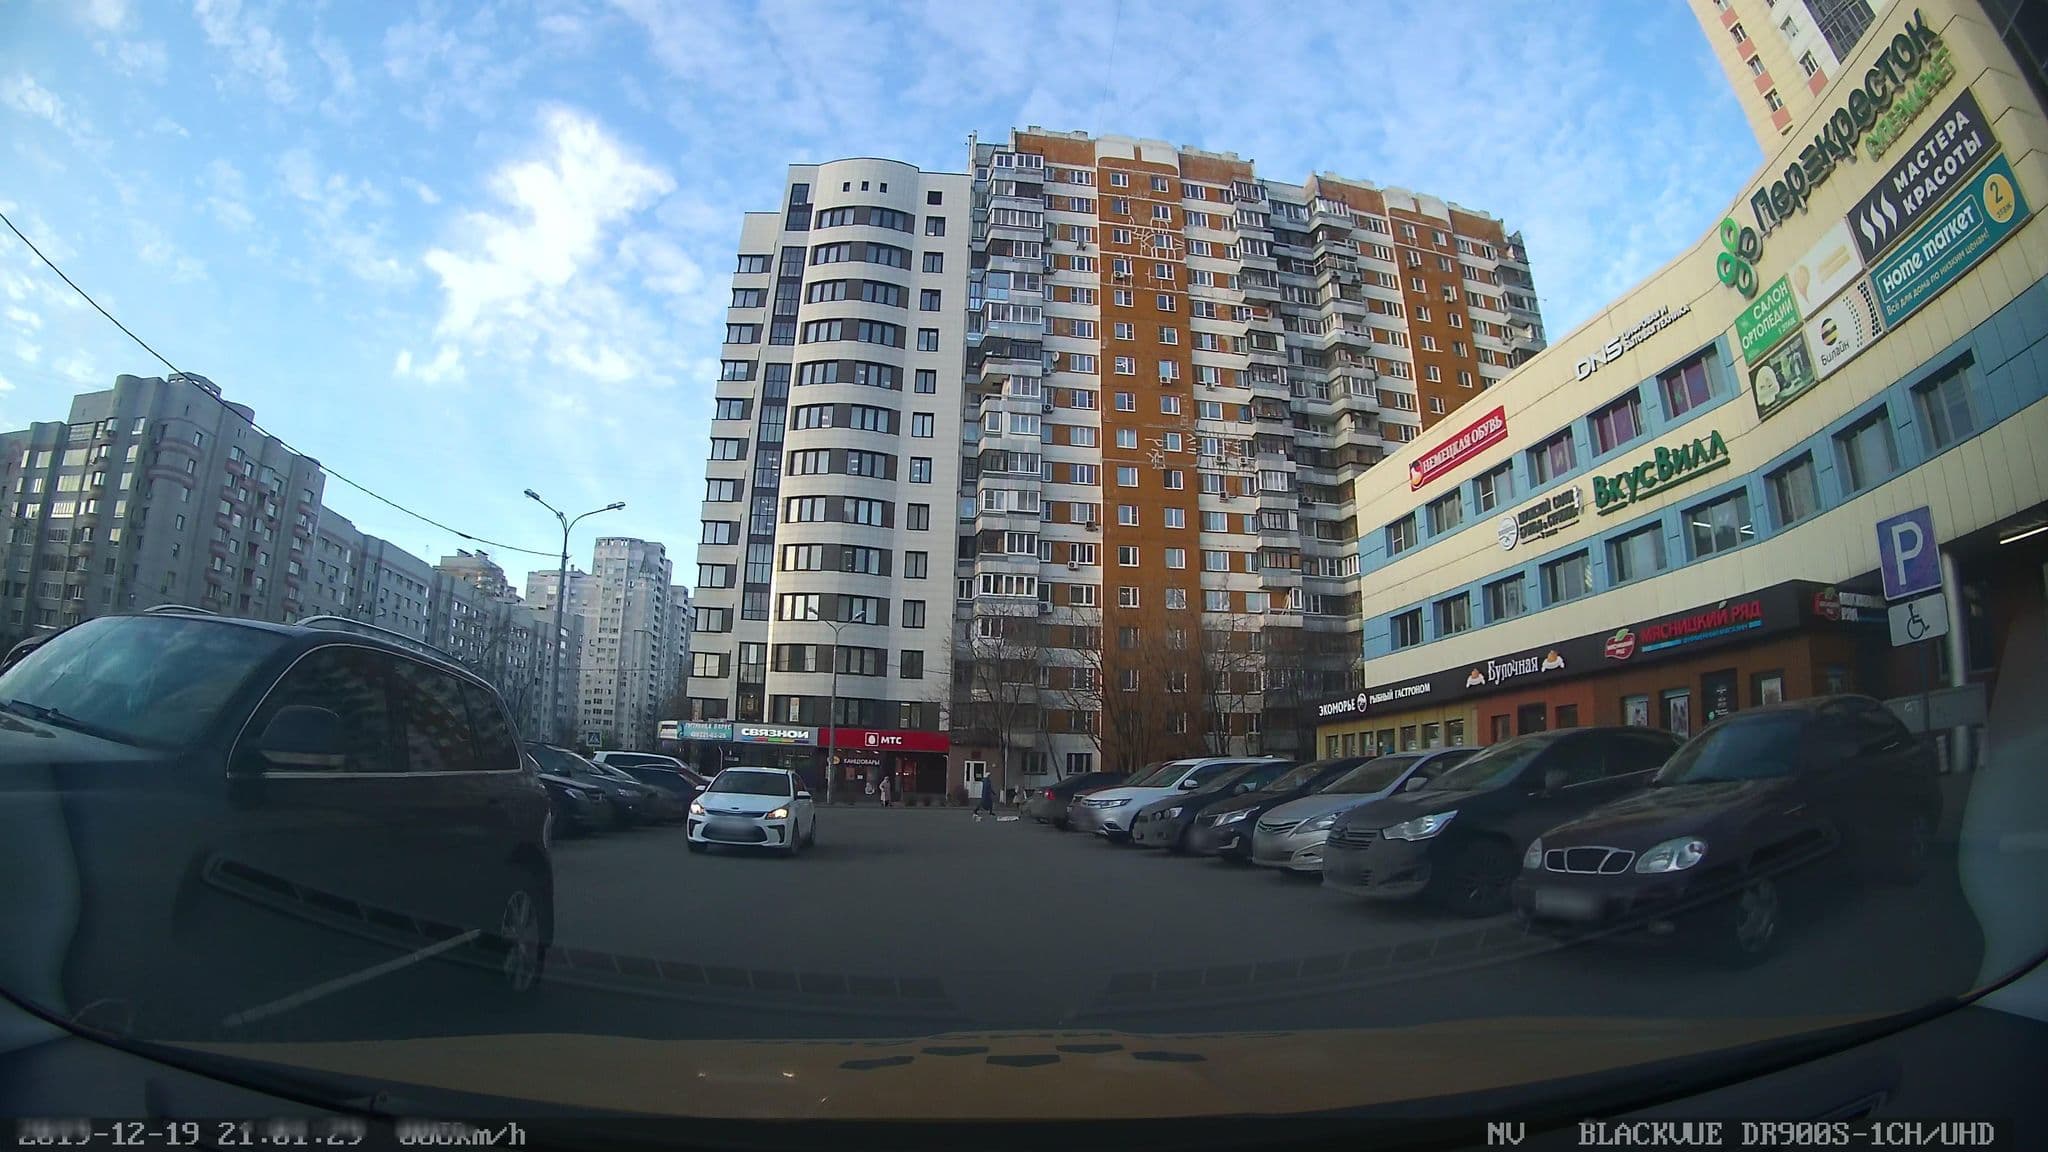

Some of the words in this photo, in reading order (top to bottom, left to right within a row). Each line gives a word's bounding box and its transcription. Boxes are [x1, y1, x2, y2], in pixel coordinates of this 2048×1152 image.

[1893, 110, 1970, 193] МАСТЕРА
[1902, 130, 1982, 216] КРАСОТЫ
[1990, 181, 2003, 204] 2
[1753, 281, 1789, 320] САЛОН
[1742, 300, 1794, 349] ОРТОПЕДИИ
[1576, 336, 1624, 381] DNS
[1422, 432, 1471, 474] НЕМЕЦКАЯ
[1471, 415, 1503, 443] ОБУВЬ
[1891, 521, 1923, 585] P
[1641, 610, 1728, 643] МЯСНИЦКИЙ
[1731, 600, 1762, 622] РЯД
[1487, 657, 1538, 685] Булочная
[1318, 699, 1356, 717] ЭКОМОРЬЕ
[1369, 689, 1394, 704] РЫБНЫЙ
[1395, 683, 1431, 699] ГАСТРОНОМ
[880, 736, 902, 745] МТС
